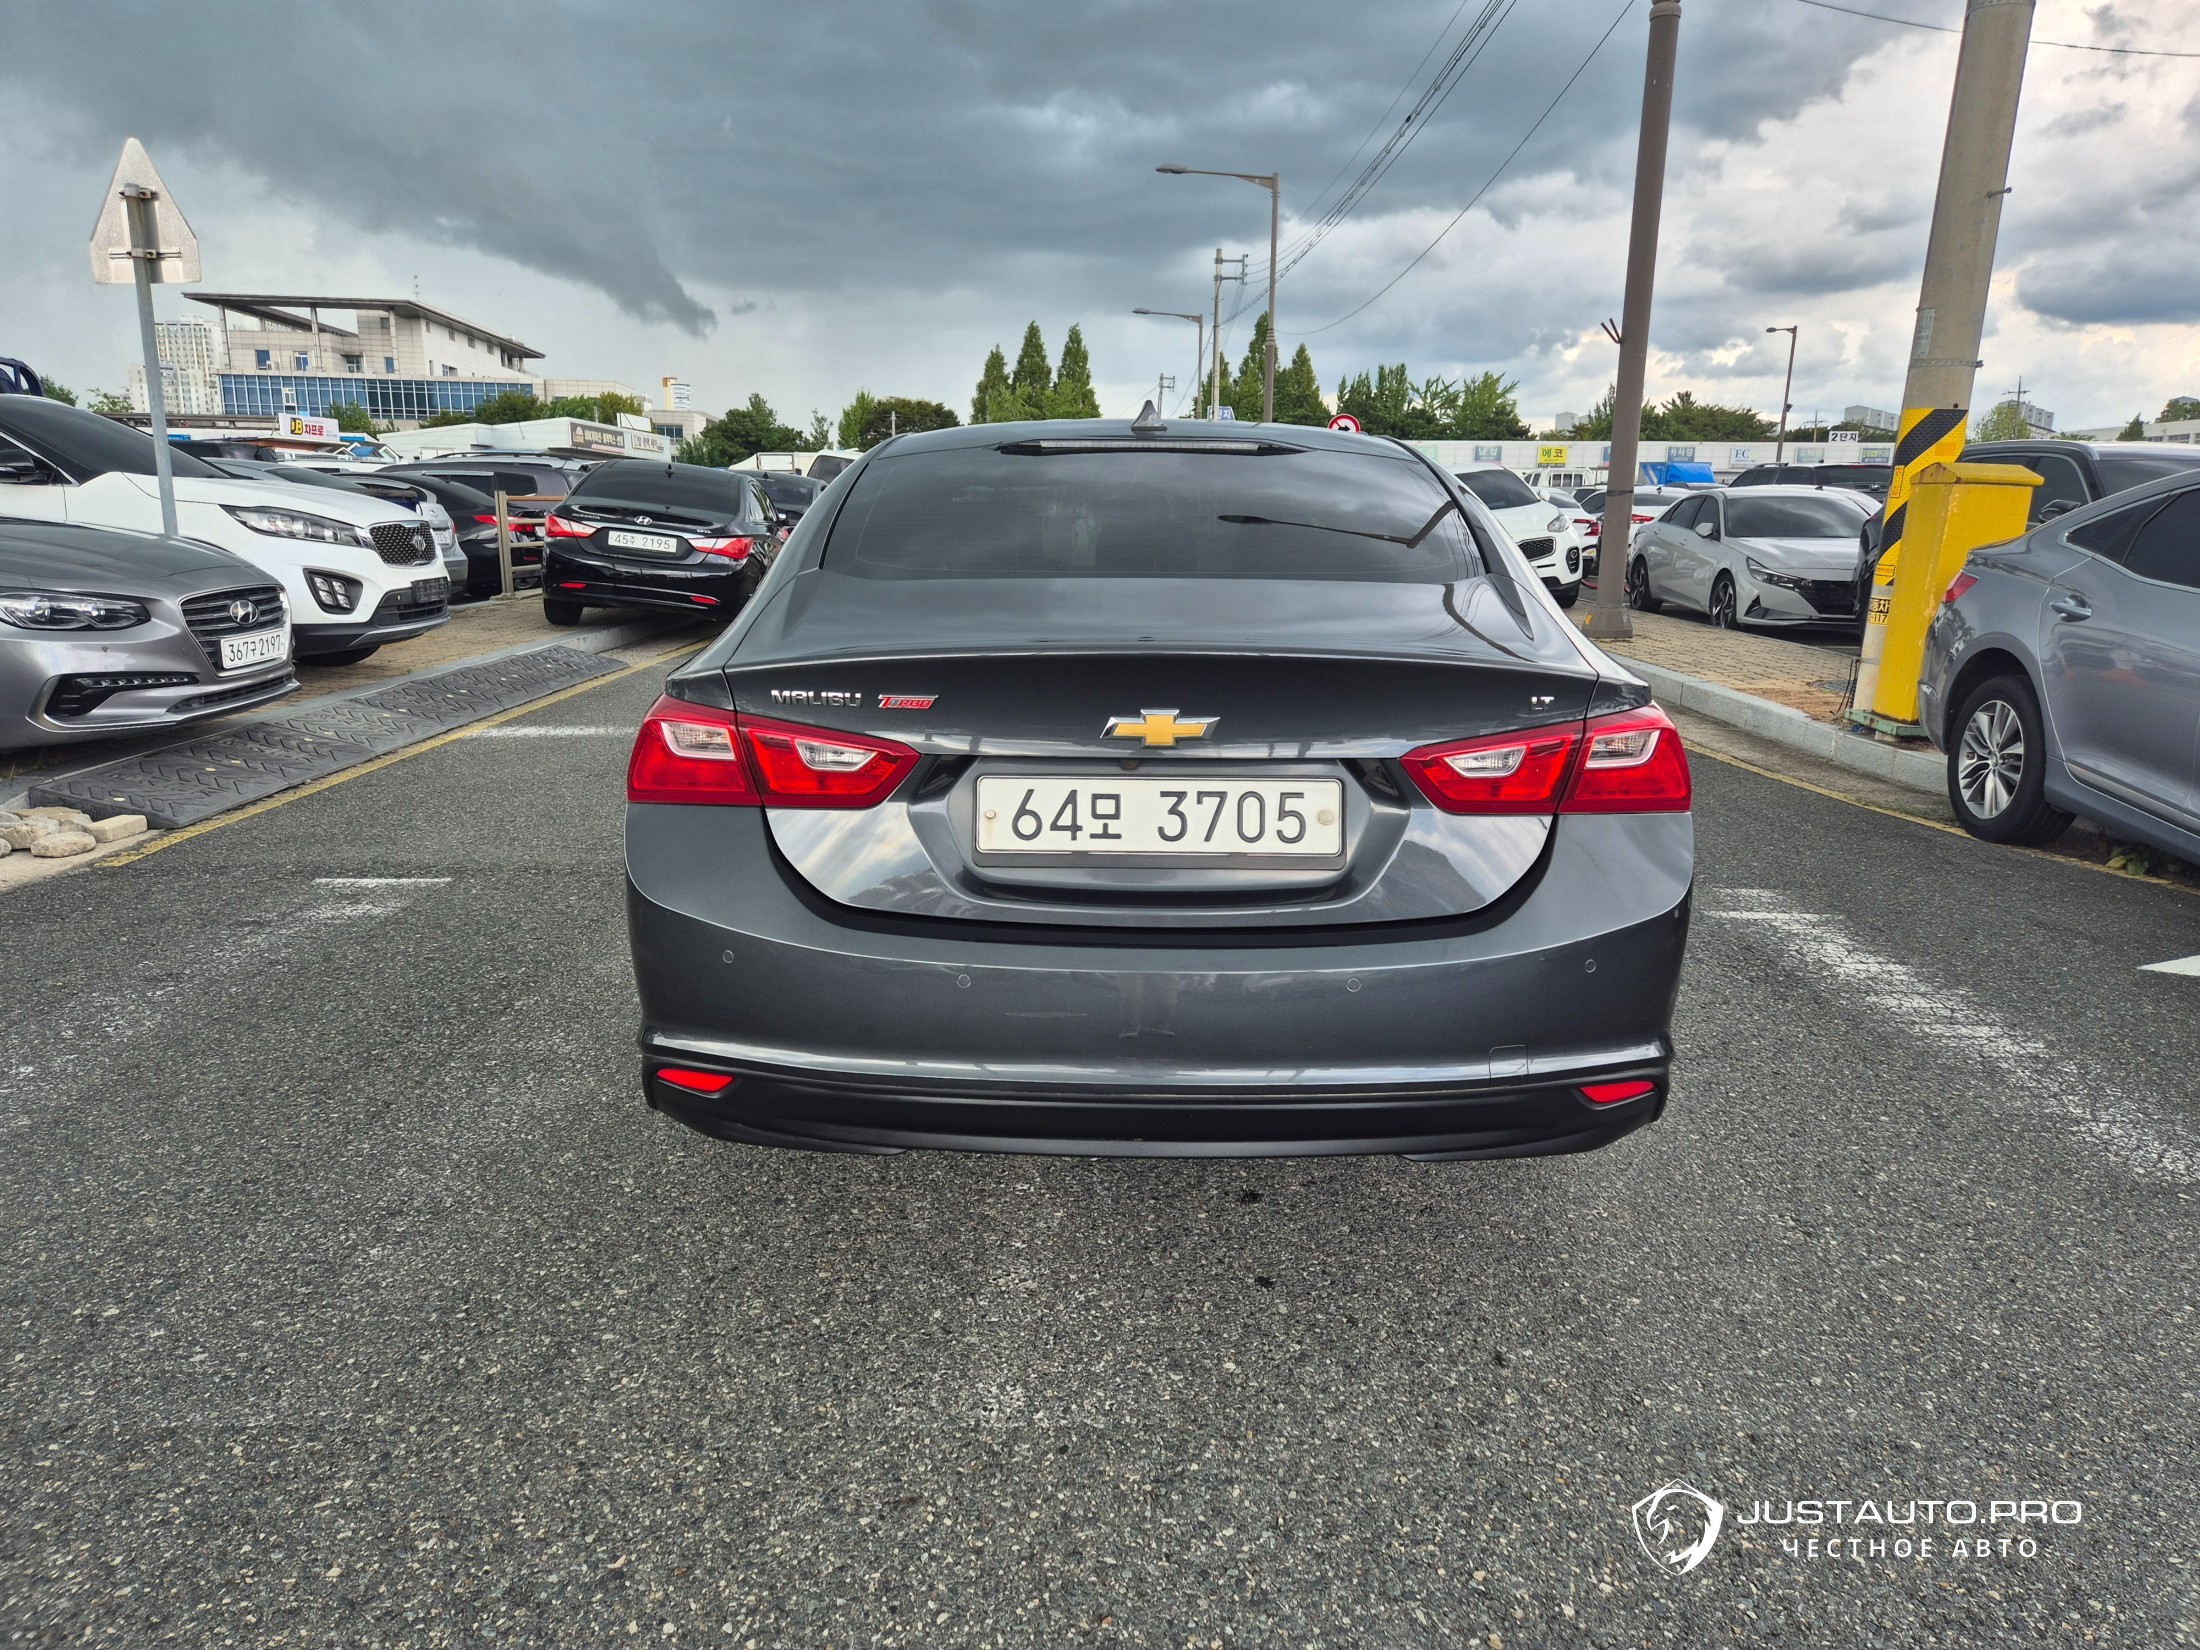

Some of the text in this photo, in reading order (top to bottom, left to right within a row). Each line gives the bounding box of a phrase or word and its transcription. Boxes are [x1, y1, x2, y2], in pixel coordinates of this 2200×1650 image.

[1831, 432, 1857, 442] 2단지
[1542, 448, 1563, 458] 에코
[642, 537, 670, 550] 2195
[1870, 599, 1889, 613] 동차
[259, 634, 280, 656] 2197
[771, 689, 939, 709] MALIBU TURBO
[1530, 696, 1555, 711] LT
[1011, 788, 1307, 844] 64모 3705
